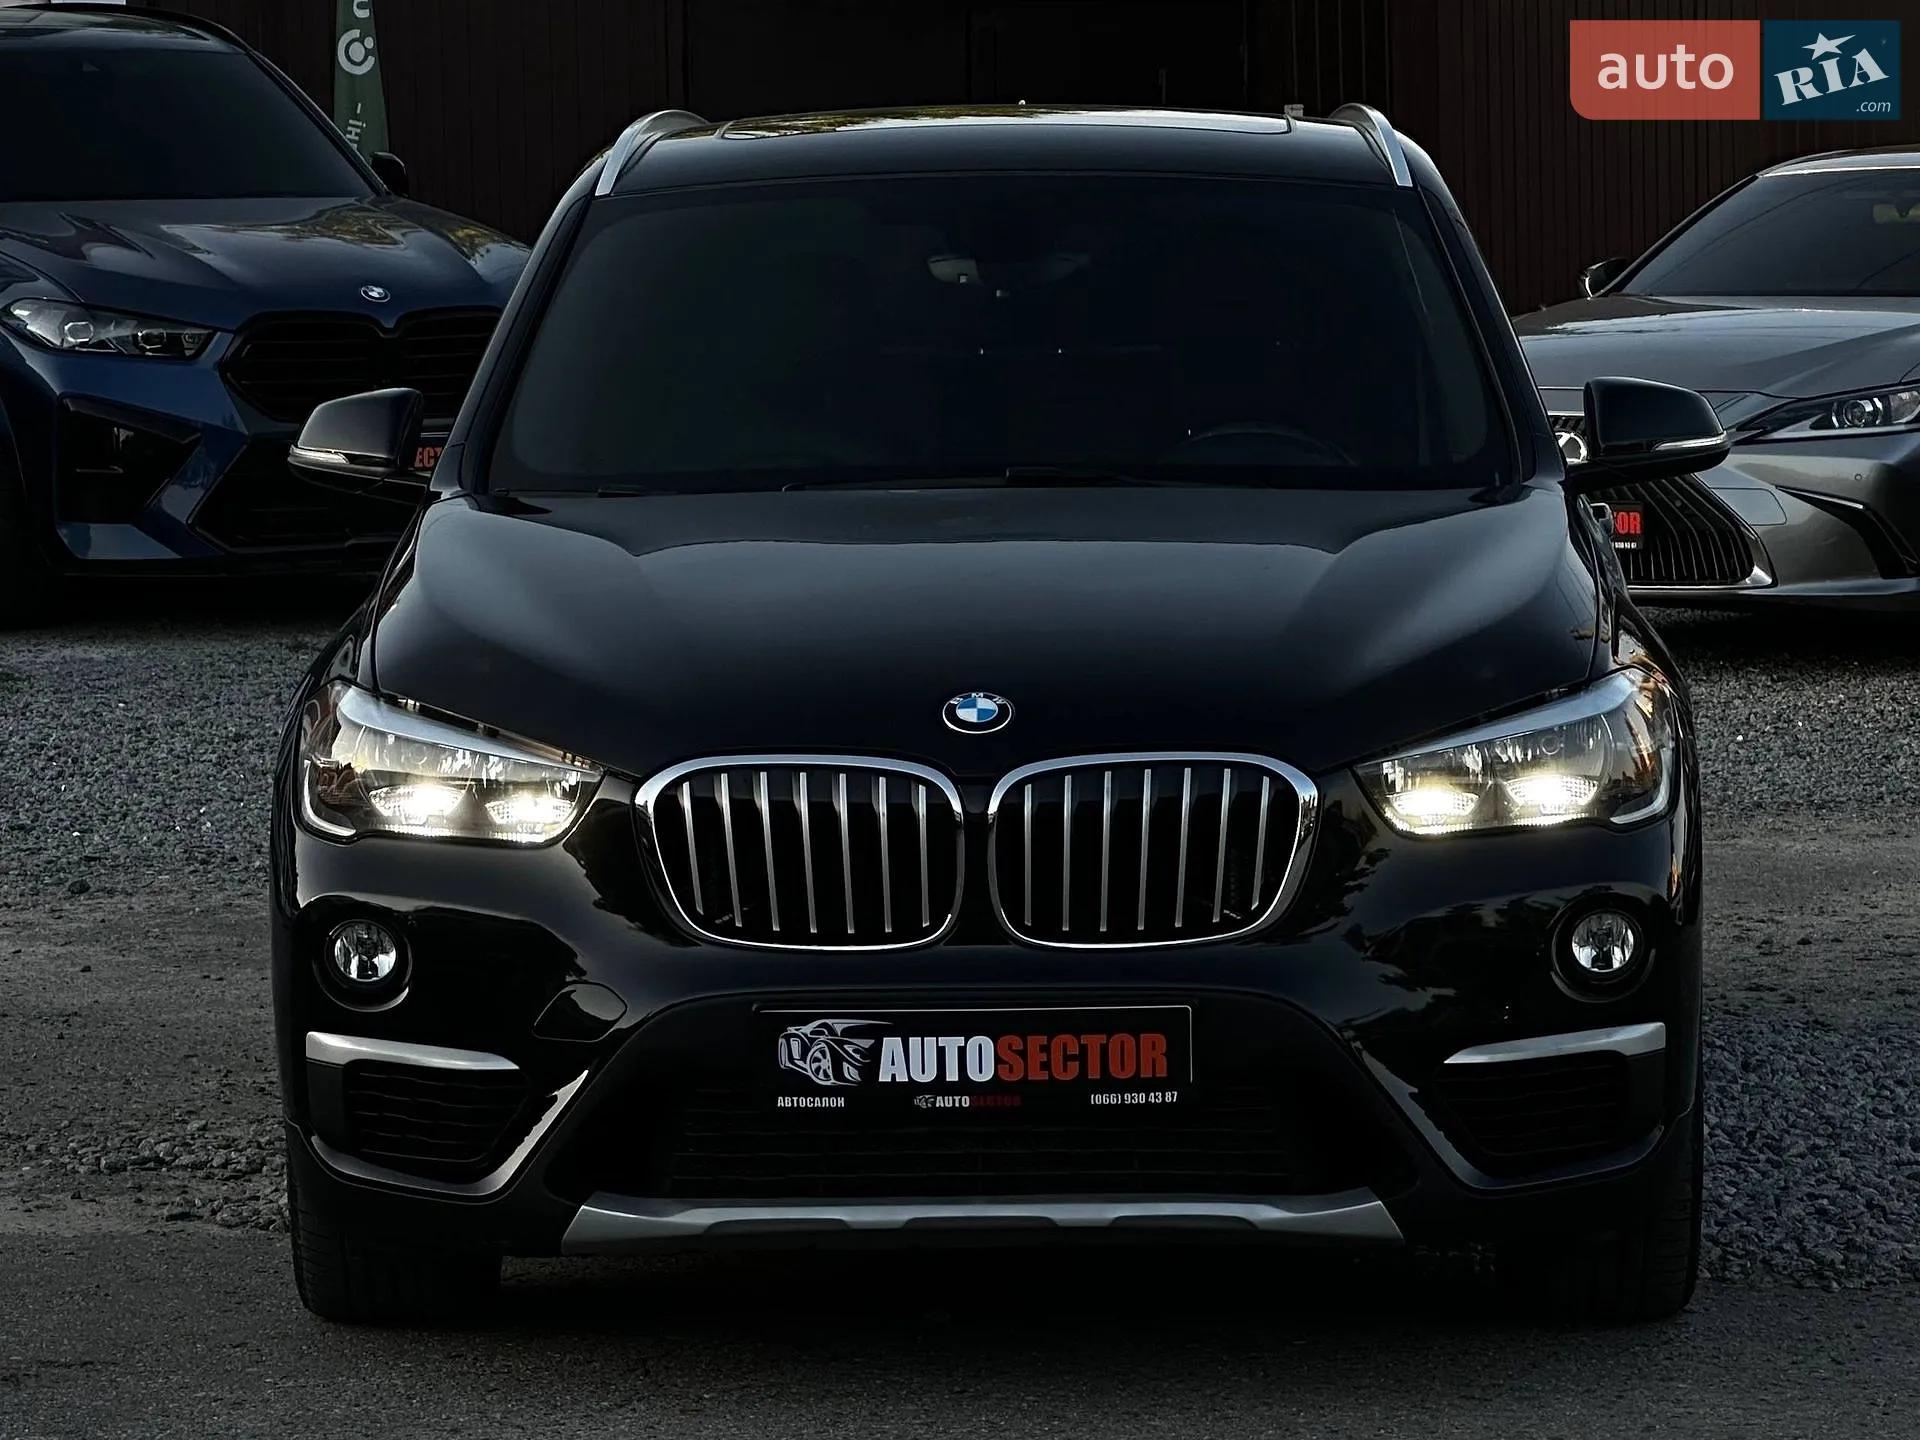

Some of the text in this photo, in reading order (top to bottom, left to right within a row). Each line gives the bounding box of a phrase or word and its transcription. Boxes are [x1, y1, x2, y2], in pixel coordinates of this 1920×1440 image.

[878, 1032, 1168, 1083] AUTOSECTOR
[777, 1096, 845, 1108] АВТОСАЛОН
[1090, 1090, 1178, 1105] (066) 930 43 87
